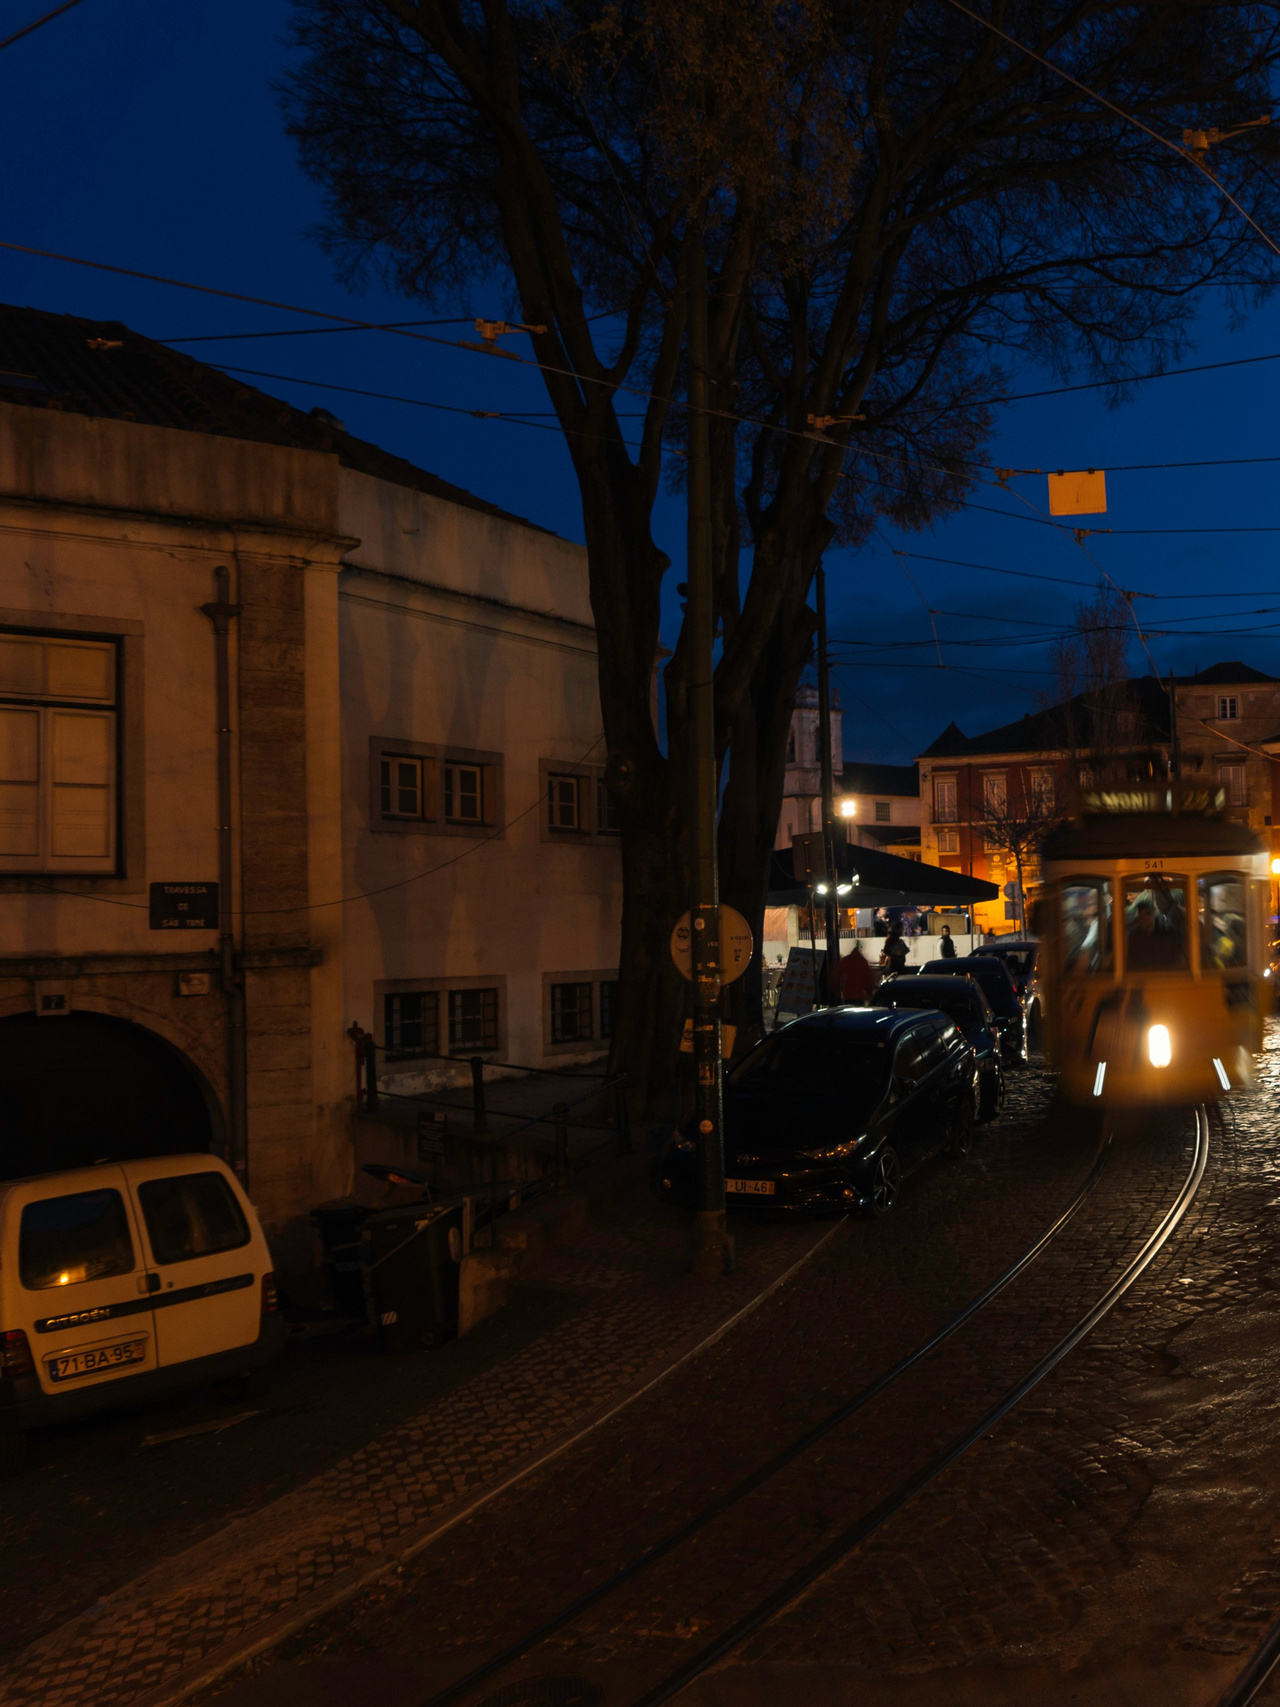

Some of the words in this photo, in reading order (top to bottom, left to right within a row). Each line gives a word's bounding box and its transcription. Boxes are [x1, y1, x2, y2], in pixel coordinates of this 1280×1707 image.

[1144, 860, 1164, 870] 541
[163, 885, 208, 895] TRAVESSA
[46, 1307, 112, 1330] CITROËN
[59, 1344, 134, 1375] 71-BA-95
